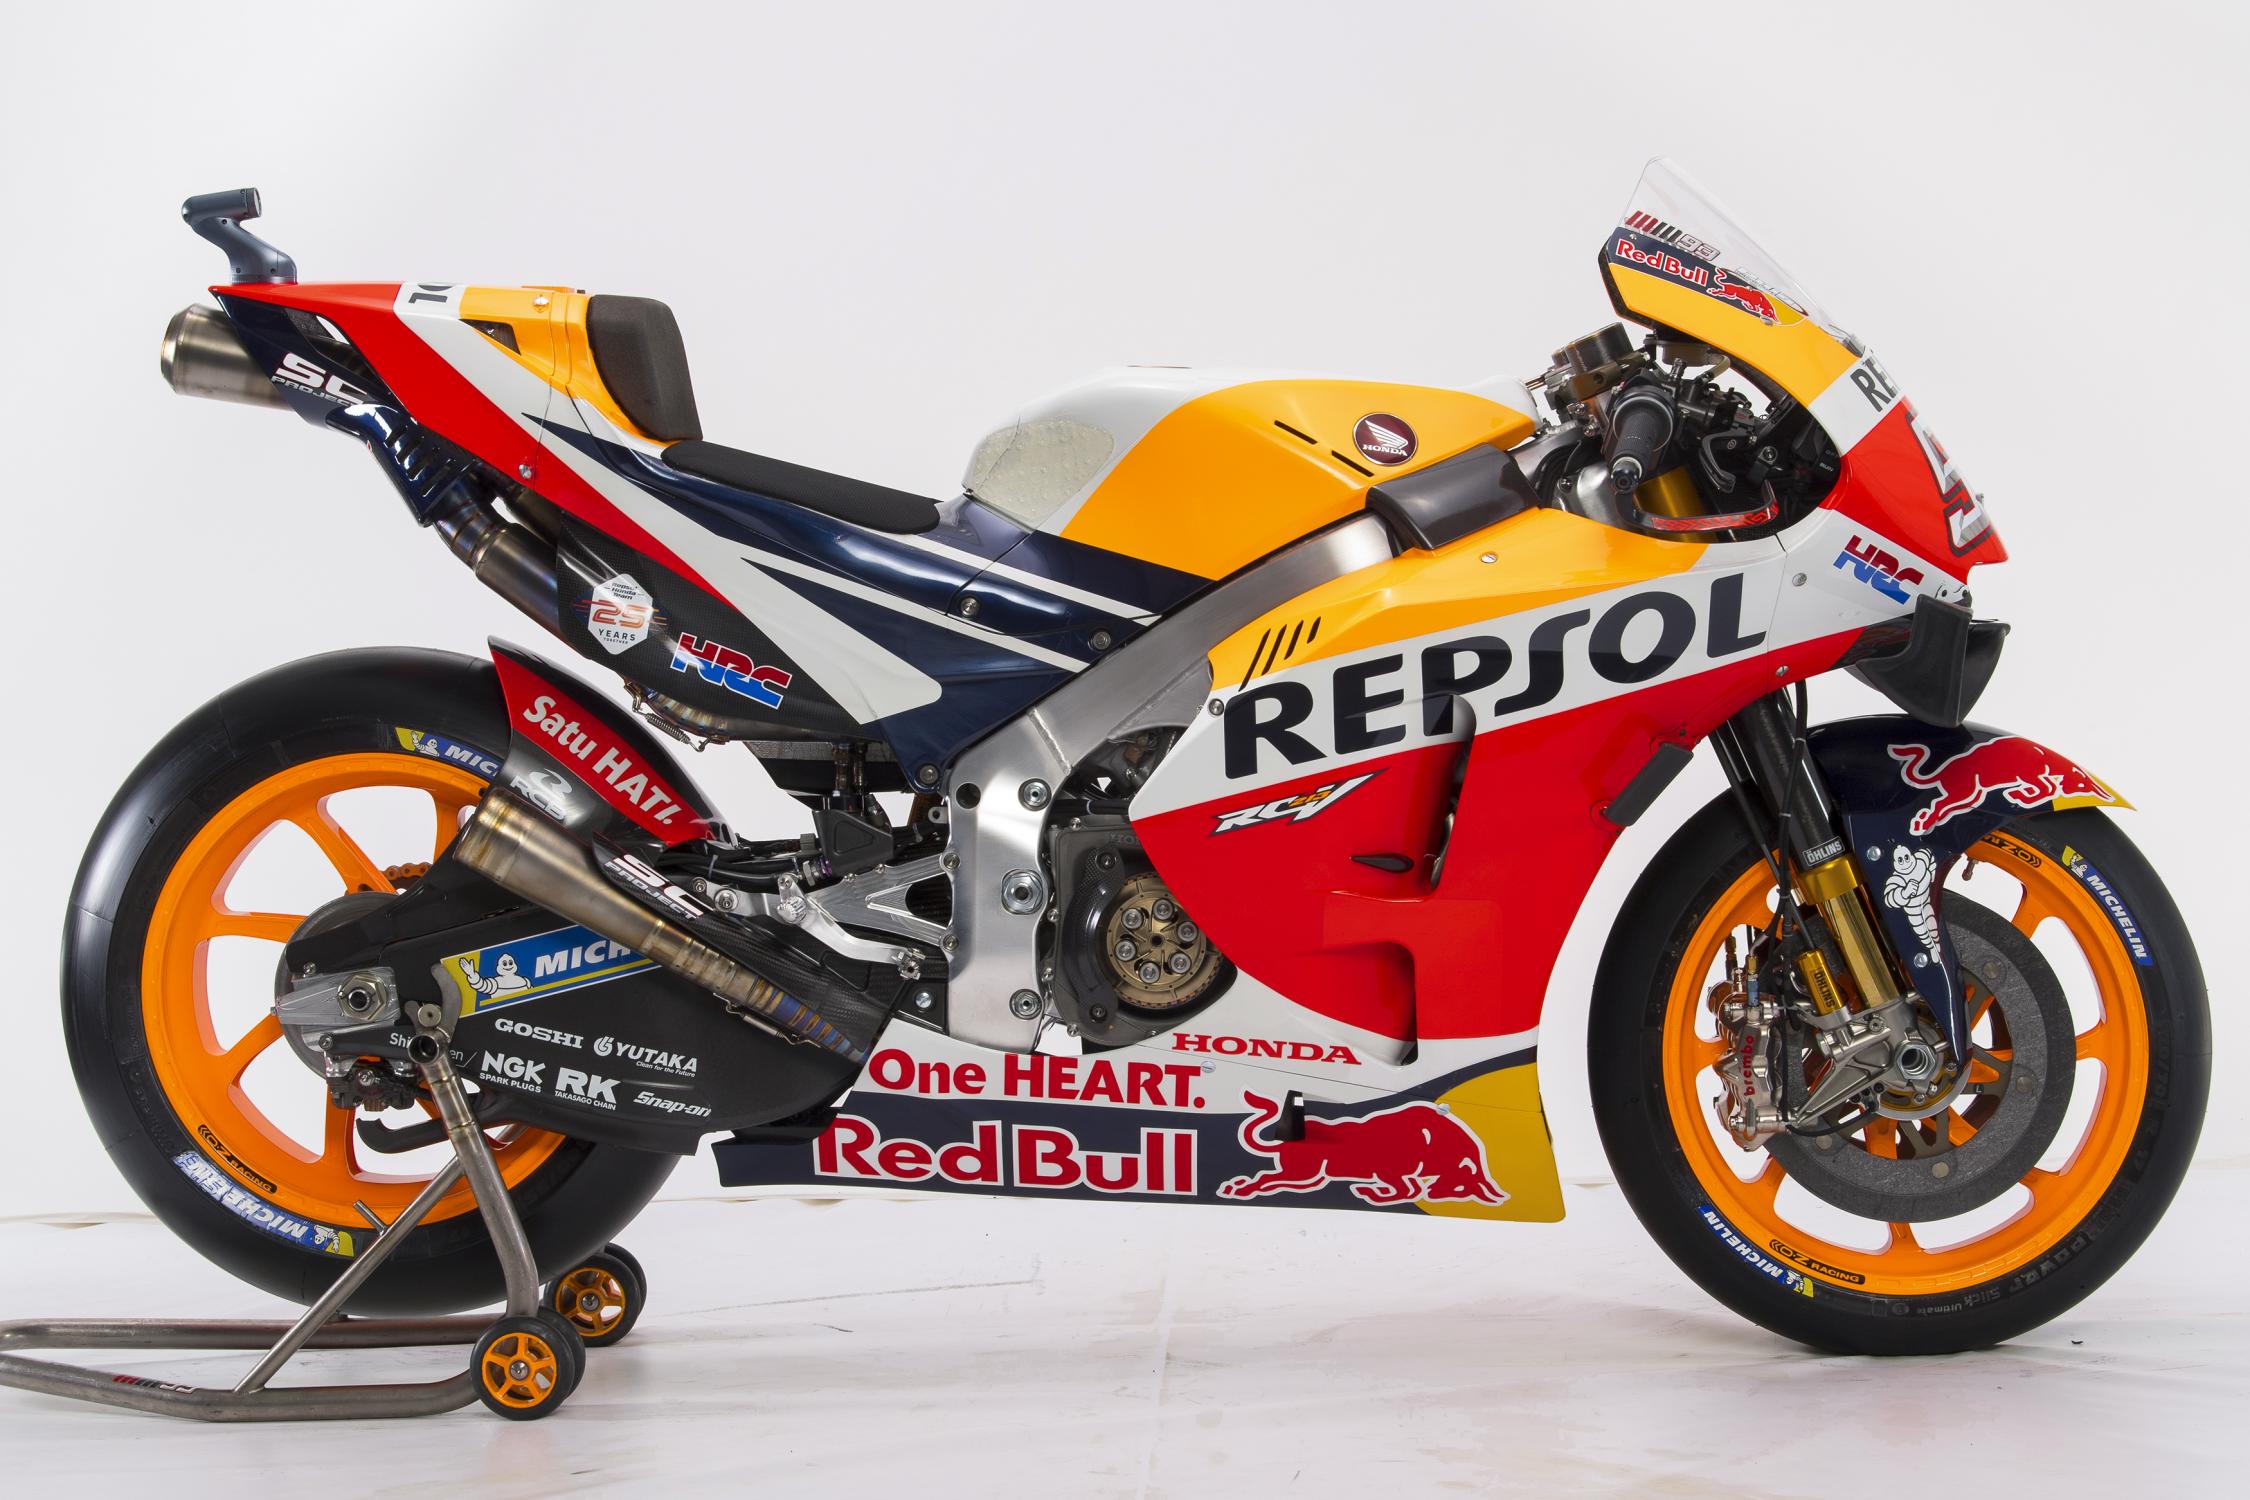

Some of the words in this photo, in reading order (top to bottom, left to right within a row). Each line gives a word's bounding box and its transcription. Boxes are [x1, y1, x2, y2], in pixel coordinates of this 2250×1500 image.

[1616, 239, 1664, 269] Red
[1663, 255, 1709, 287] Bull
[271, 375, 355, 408] PROJEC
[1362, 444, 1408, 457] HONDA
[1832, 534, 1925, 605] HRC
[592, 599, 647, 629] 25
[598, 628, 636, 642] YEARS
[603, 637, 628, 645] TOGETHER
[670, 631, 793, 710] HRC
[1223, 573, 1768, 780] REPSOL
[523, 695, 597, 761] Satu
[444, 744, 499, 778] MIC
[1806, 840, 1842, 863] ÖHLINS
[604, 861, 697, 920] PROJECT
[613, 854, 714, 917] SC
[2087, 874, 2148, 958] MICHELIN
[535, 939, 632, 978] MICH
[1813, 967, 1836, 1009] ÖHLINS
[495, 1018, 584, 1049] GOSHI
[1172, 1032, 1362, 1065] HONDA
[481, 1050, 546, 1085] NGK
[616, 1042, 698, 1072] YUTAKA
[636, 1060, 654, 1069] Clean
[664, 1066, 675, 1074] the
[675, 1068, 696, 1078] Future
[1741, 1035, 1755, 1097] brembo
[480, 1072, 509, 1086] SPARK
[511, 1080, 542, 1093] PLUGS
[555, 1067, 622, 1104] RK
[868, 1048, 987, 1094] One
[1003, 1053, 1206, 1109] HEART.
[554, 1090, 593, 1105] TAKASAGO
[593, 1099, 617, 1111] CHAIN
[633, 1091, 712, 1118] Snap-on
[812, 1113, 1004, 1187] Red
[1011, 1124, 1198, 1196] Bull
[231, 1159, 273, 1192] RACING
[1703, 1211, 1784, 1278] MICHELIN
[1811, 1263, 1860, 1283] RACING
